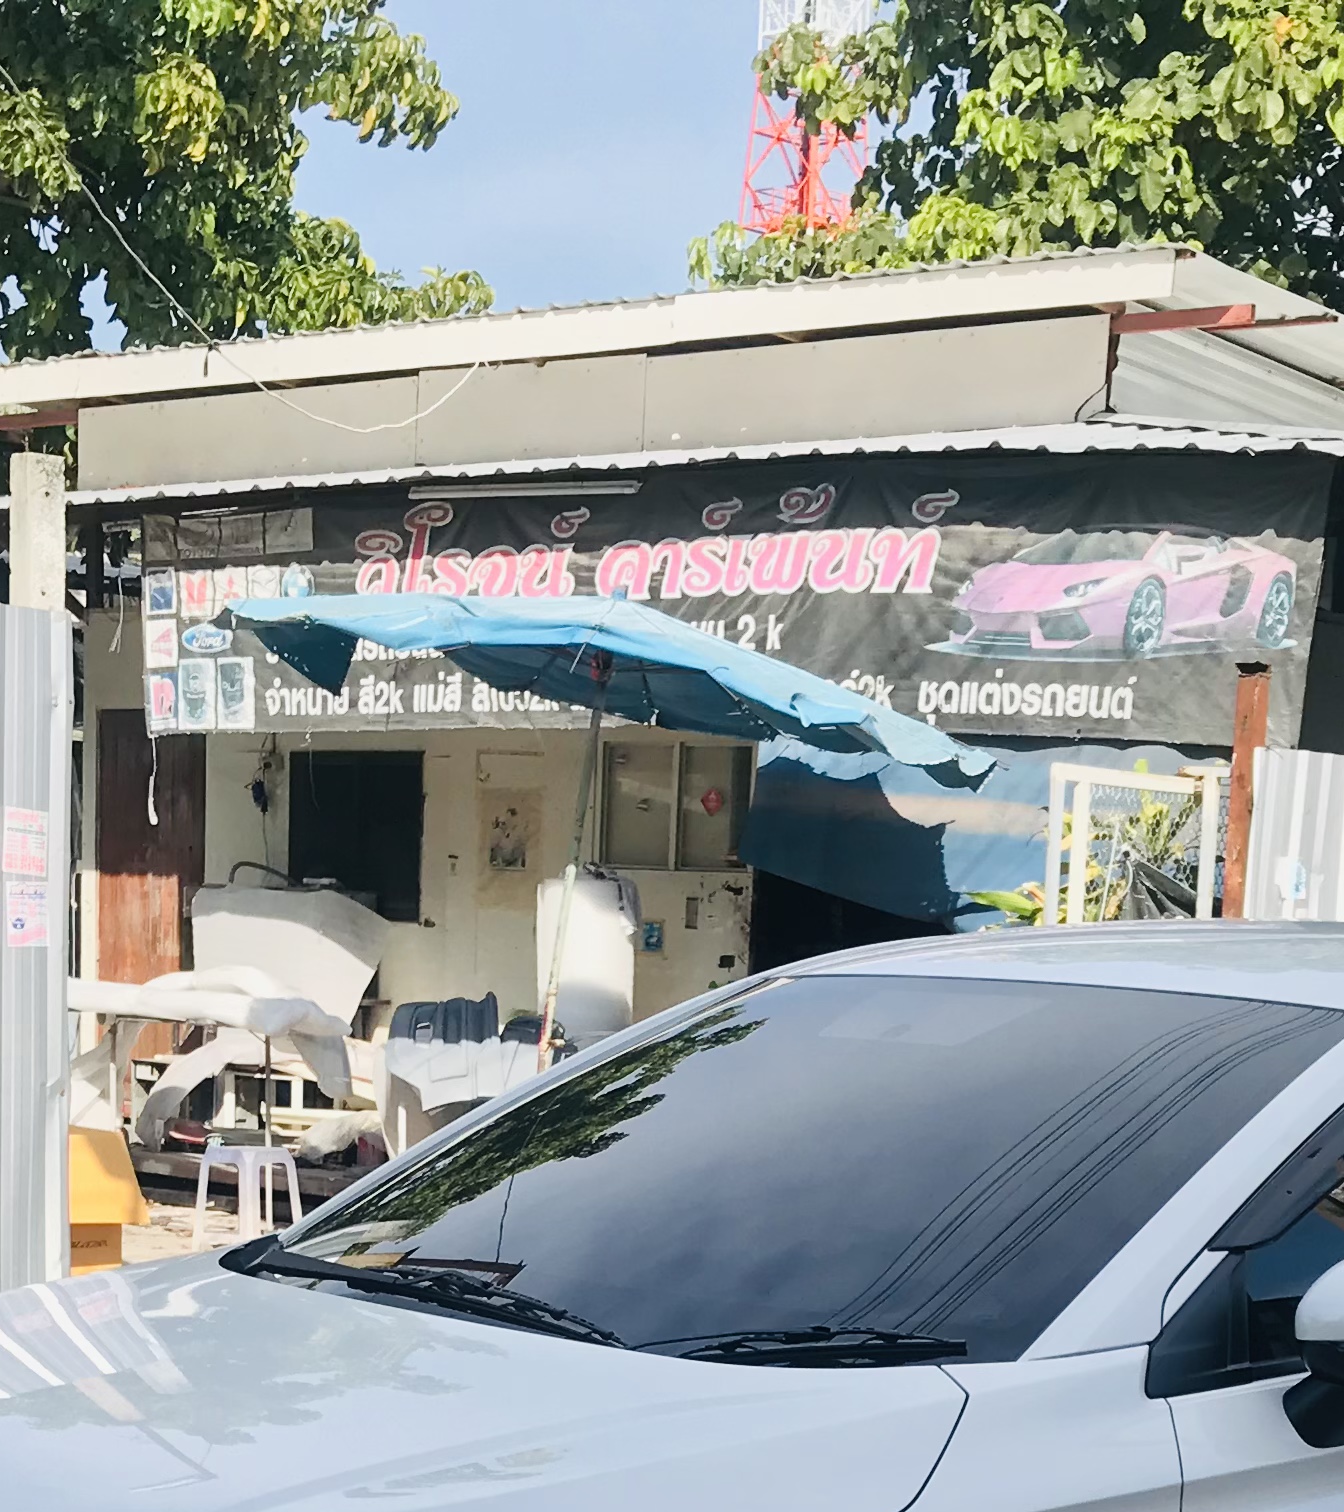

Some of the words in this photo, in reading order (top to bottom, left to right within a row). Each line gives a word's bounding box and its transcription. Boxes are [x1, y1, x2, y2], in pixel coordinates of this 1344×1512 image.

[917, 668, 1138, 725] ชุดแต่งรถยนต์
